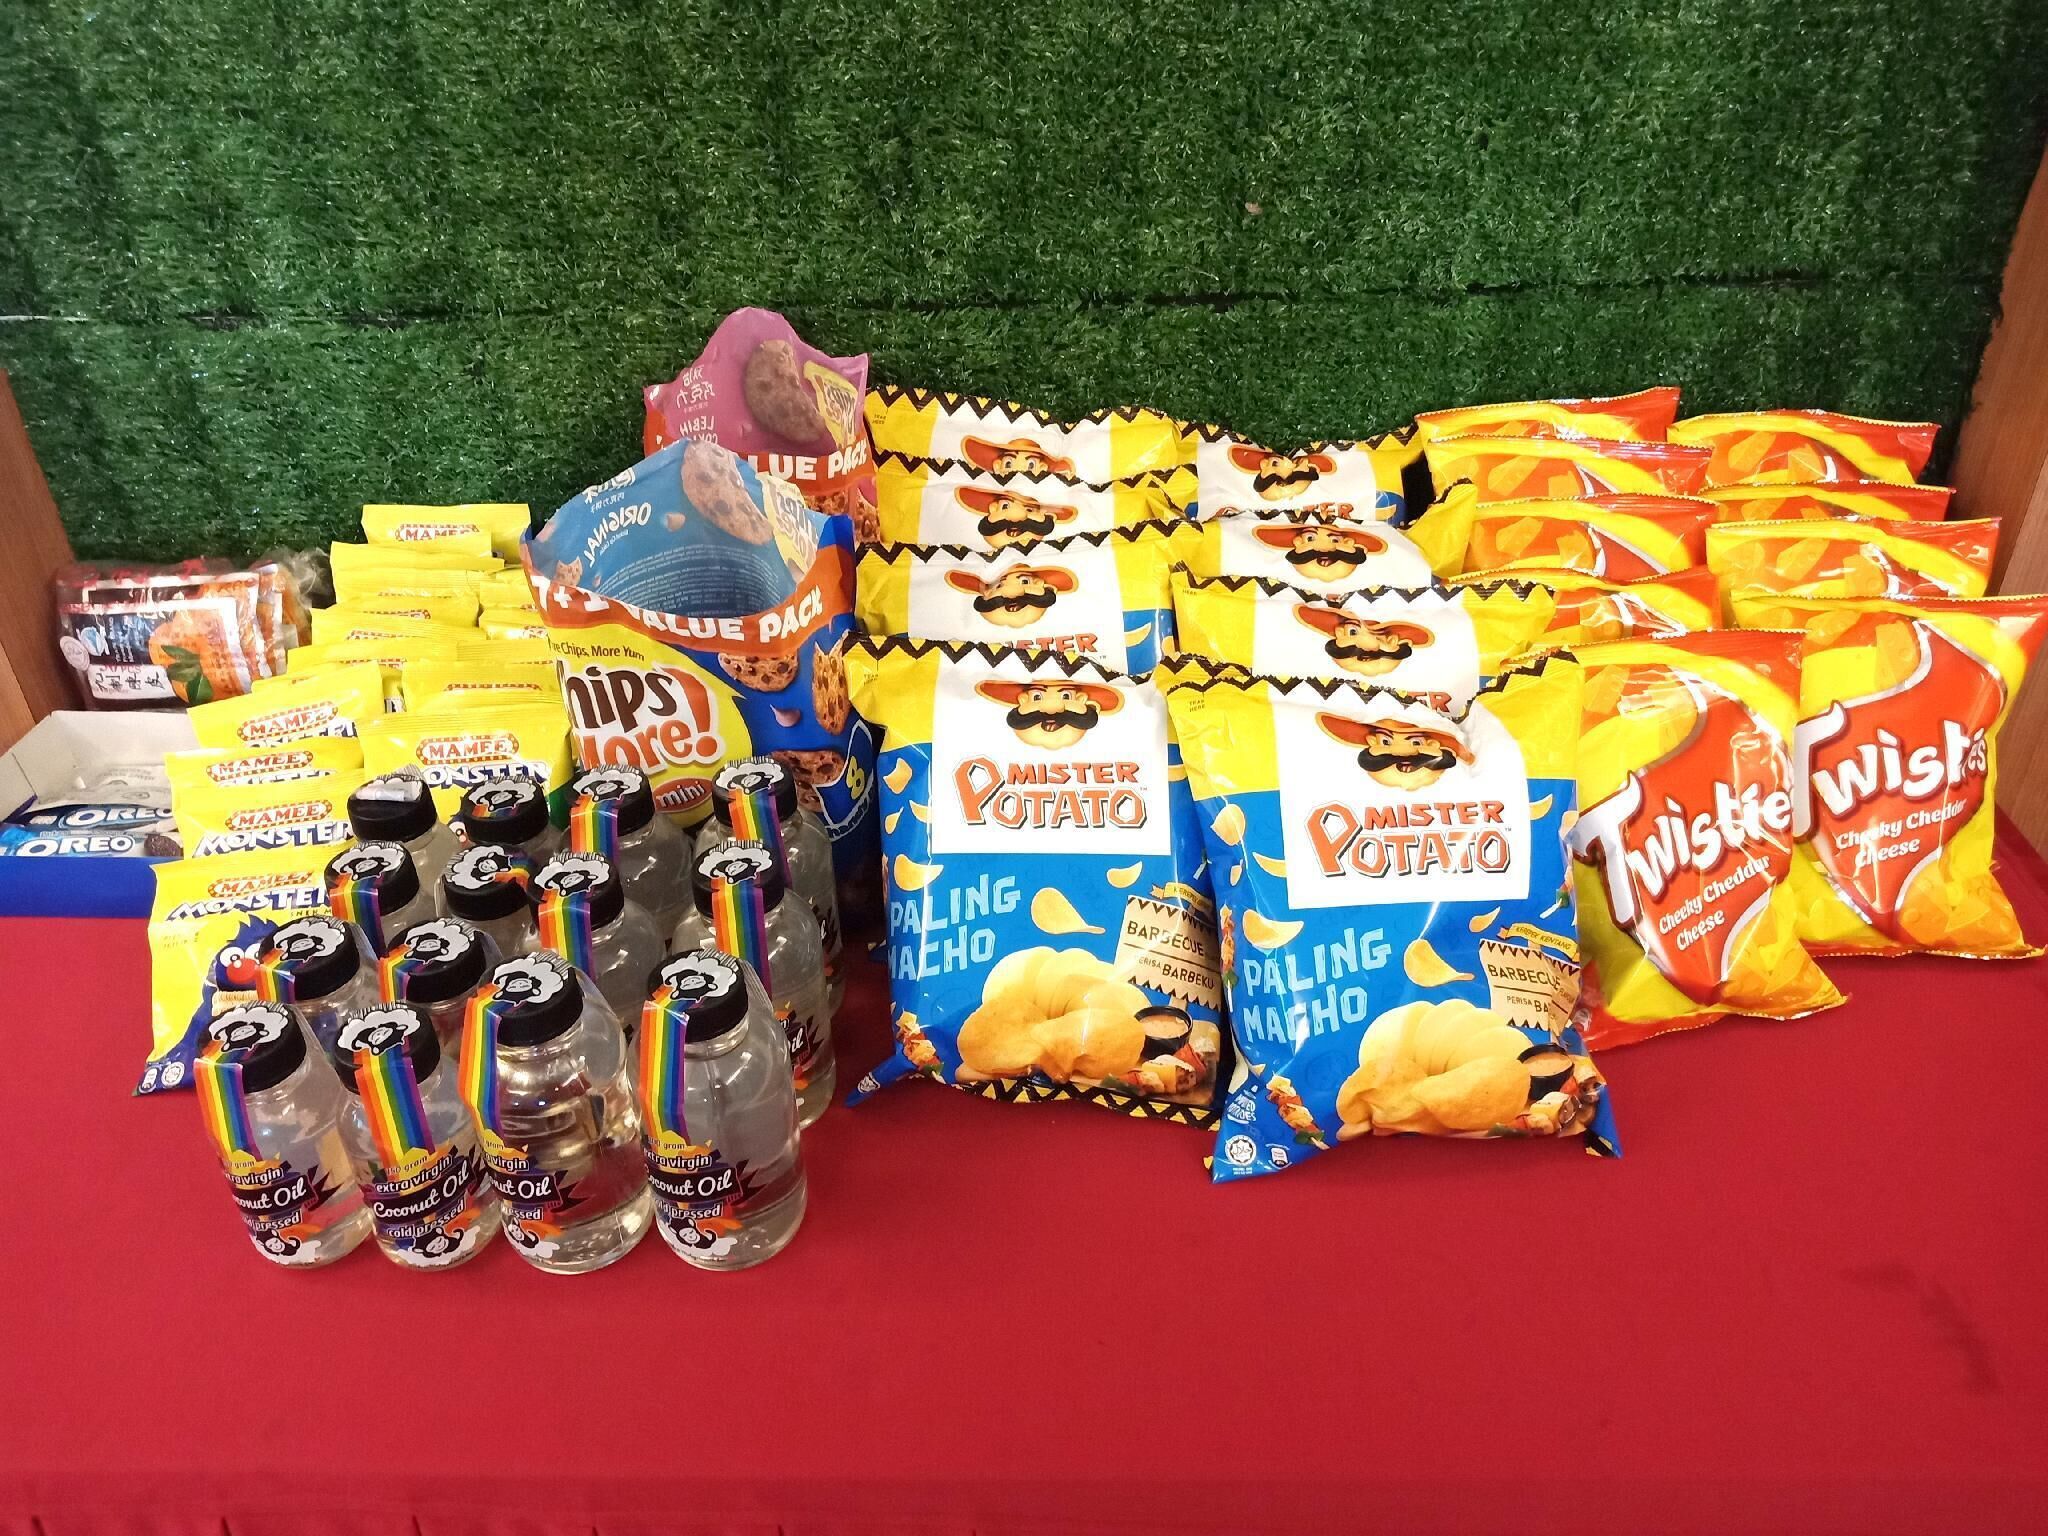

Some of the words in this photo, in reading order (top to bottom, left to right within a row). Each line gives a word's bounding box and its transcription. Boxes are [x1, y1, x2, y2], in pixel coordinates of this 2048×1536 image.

[748, 454, 816, 481] LUE
[828, 438, 868, 480] PACK
[758, 584, 823, 643] PACK
[591, 645, 620, 657] More
[623, 645, 645, 661] Yum
[429, 739, 507, 759] MAMEE
[420, 763, 549, 790] ONSTER
[846, 756, 865, 799] 8
[1007, 762, 1140, 785] MISTER
[656, 782, 705, 808] mini
[953, 756, 1147, 829] POTATO
[238, 803, 319, 826] MAMEE
[1364, 801, 1505, 829] MISTER
[16, 836, 134, 856] OREO
[1305, 802, 1509, 878] POTATO
[890, 873, 1021, 937] PALING
[1659, 894, 1702, 935] Cheeky
[1703, 855, 1771, 904] Cheddar
[1676, 909, 1725, 951] Cheese
[1244, 928, 1391, 996] PALING
[1162, 964, 1215, 990] BARBEKU
[1243, 985, 1368, 1043] MACHO
[664, 1142, 685, 1150] gram
[243, 1167, 281, 1185] virgin
[376, 1179, 410, 1193] extra
[412, 1155, 451, 1185] virgin
[404, 1155, 428, 1173] gram
[492, 1157, 527, 1172] virgin
[669, 1155, 710, 1171] virgin
[274, 1176, 307, 1207] Oil
[373, 1188, 441, 1218] Coconut
[442, 1159, 470, 1198] Oil
[518, 1176, 552, 1199] Oil
[698, 1169, 733, 1196] Oil
[256, 1211, 301, 1231] pressed
[388, 1224, 413, 1238] cold
[416, 1199, 465, 1237] pressed
[671, 1204, 721, 1220] pressed
